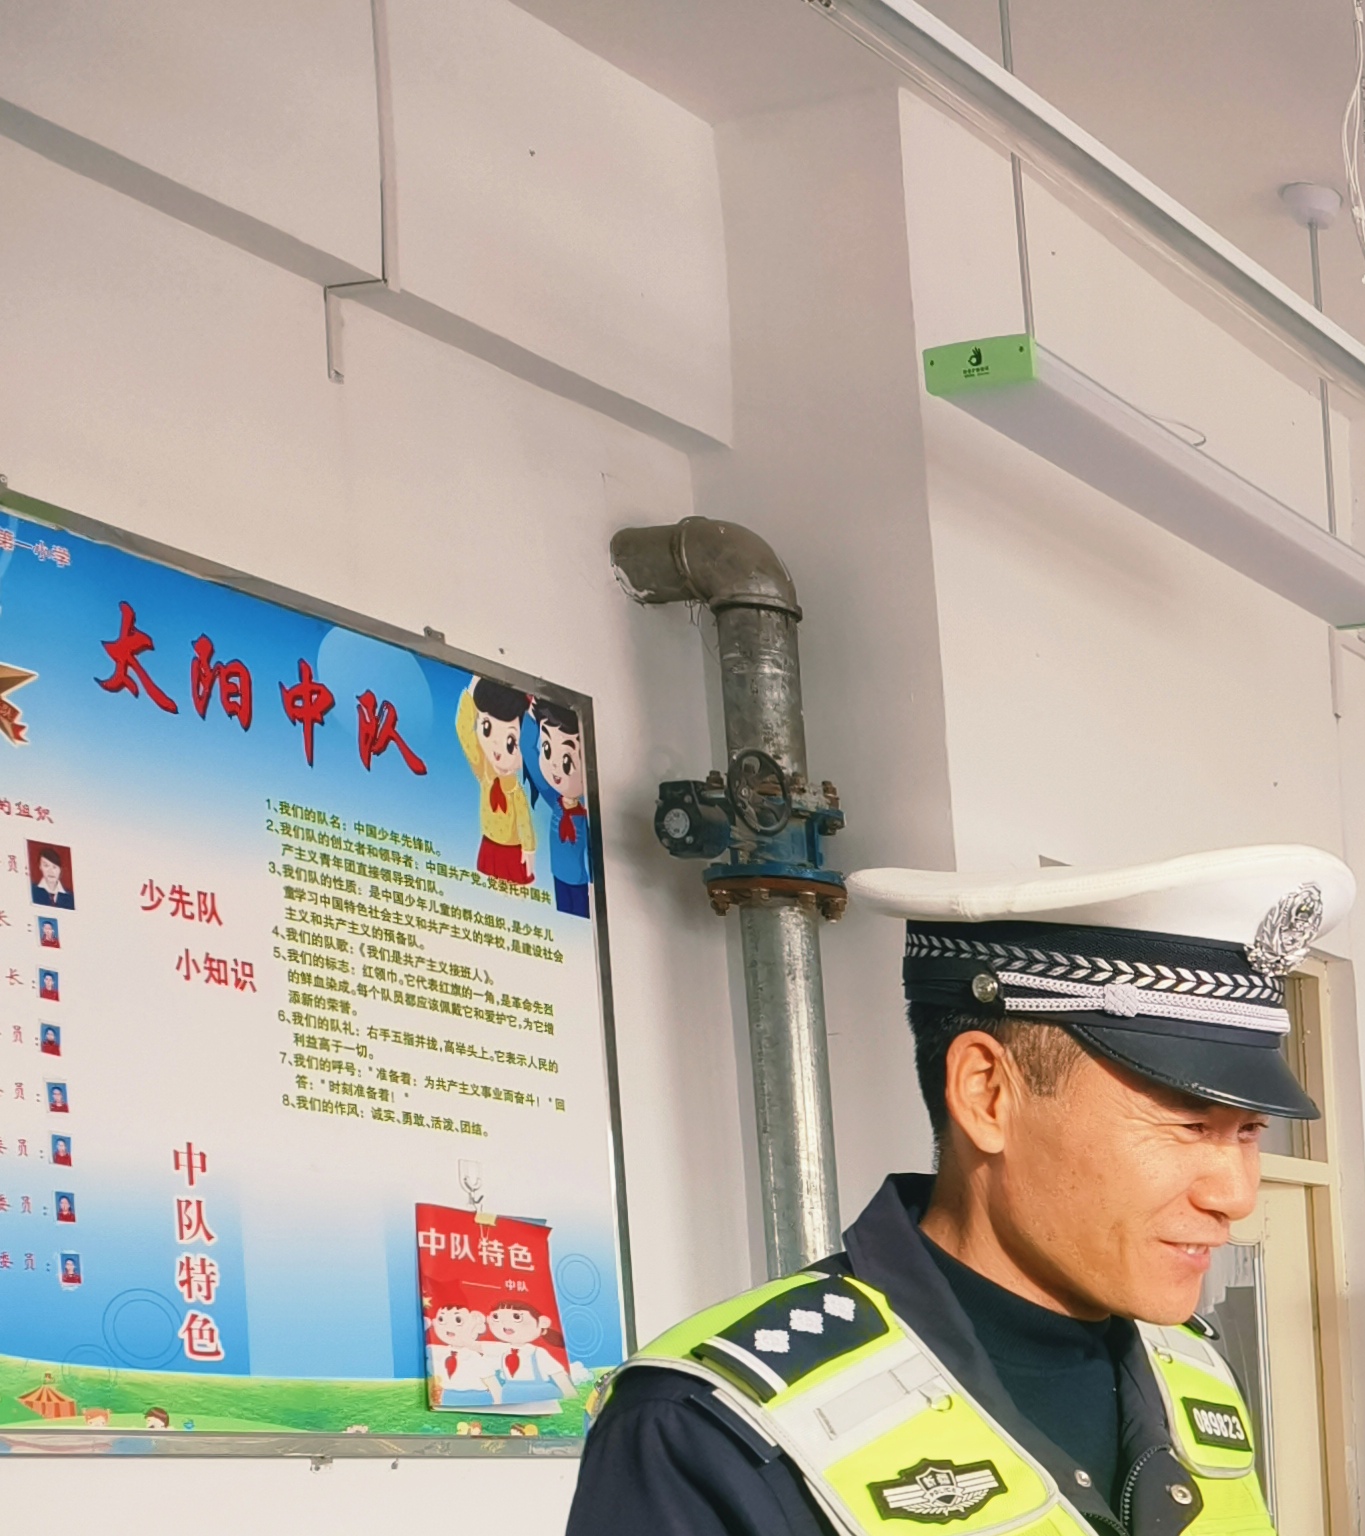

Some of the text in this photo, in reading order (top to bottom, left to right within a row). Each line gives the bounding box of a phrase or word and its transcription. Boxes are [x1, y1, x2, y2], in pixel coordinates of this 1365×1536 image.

[93, 601, 428, 776] 太阳中队
[139, 878, 224, 927] 少先队
[174, 948, 258, 993] 小知识
[172, 1141, 225, 1361] 中队特色
[418, 1227, 535, 1272] 中队特色
